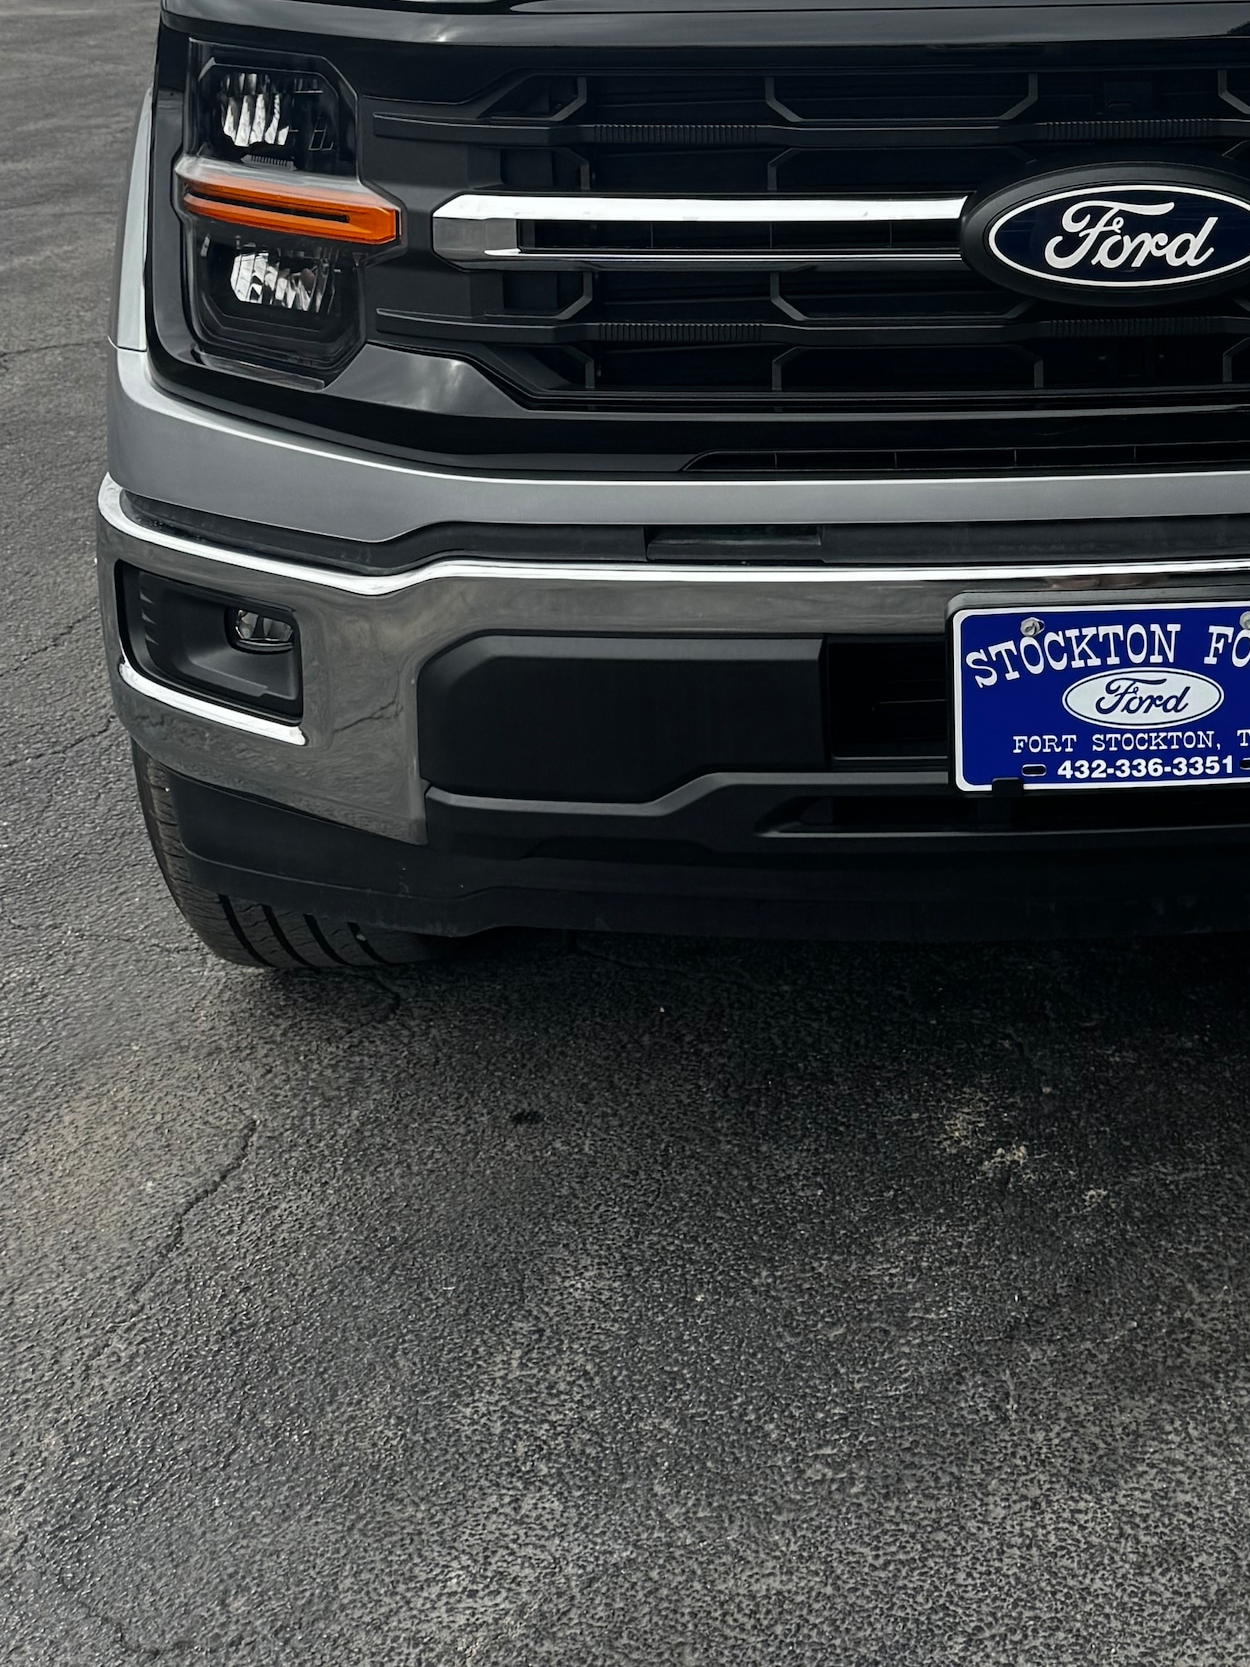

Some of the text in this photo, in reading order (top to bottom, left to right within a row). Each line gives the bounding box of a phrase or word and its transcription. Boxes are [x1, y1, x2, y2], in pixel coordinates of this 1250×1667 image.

[1044, 200, 1219, 269] Ford
[965, 623, 1182, 689] STOCKTON
[1094, 677, 1192, 715] Ford
[1012, 734, 1077, 754] FORT
[1092, 730, 1222, 752] STOCKTON,
[1057, 755, 1234, 780] 432-336-3351
